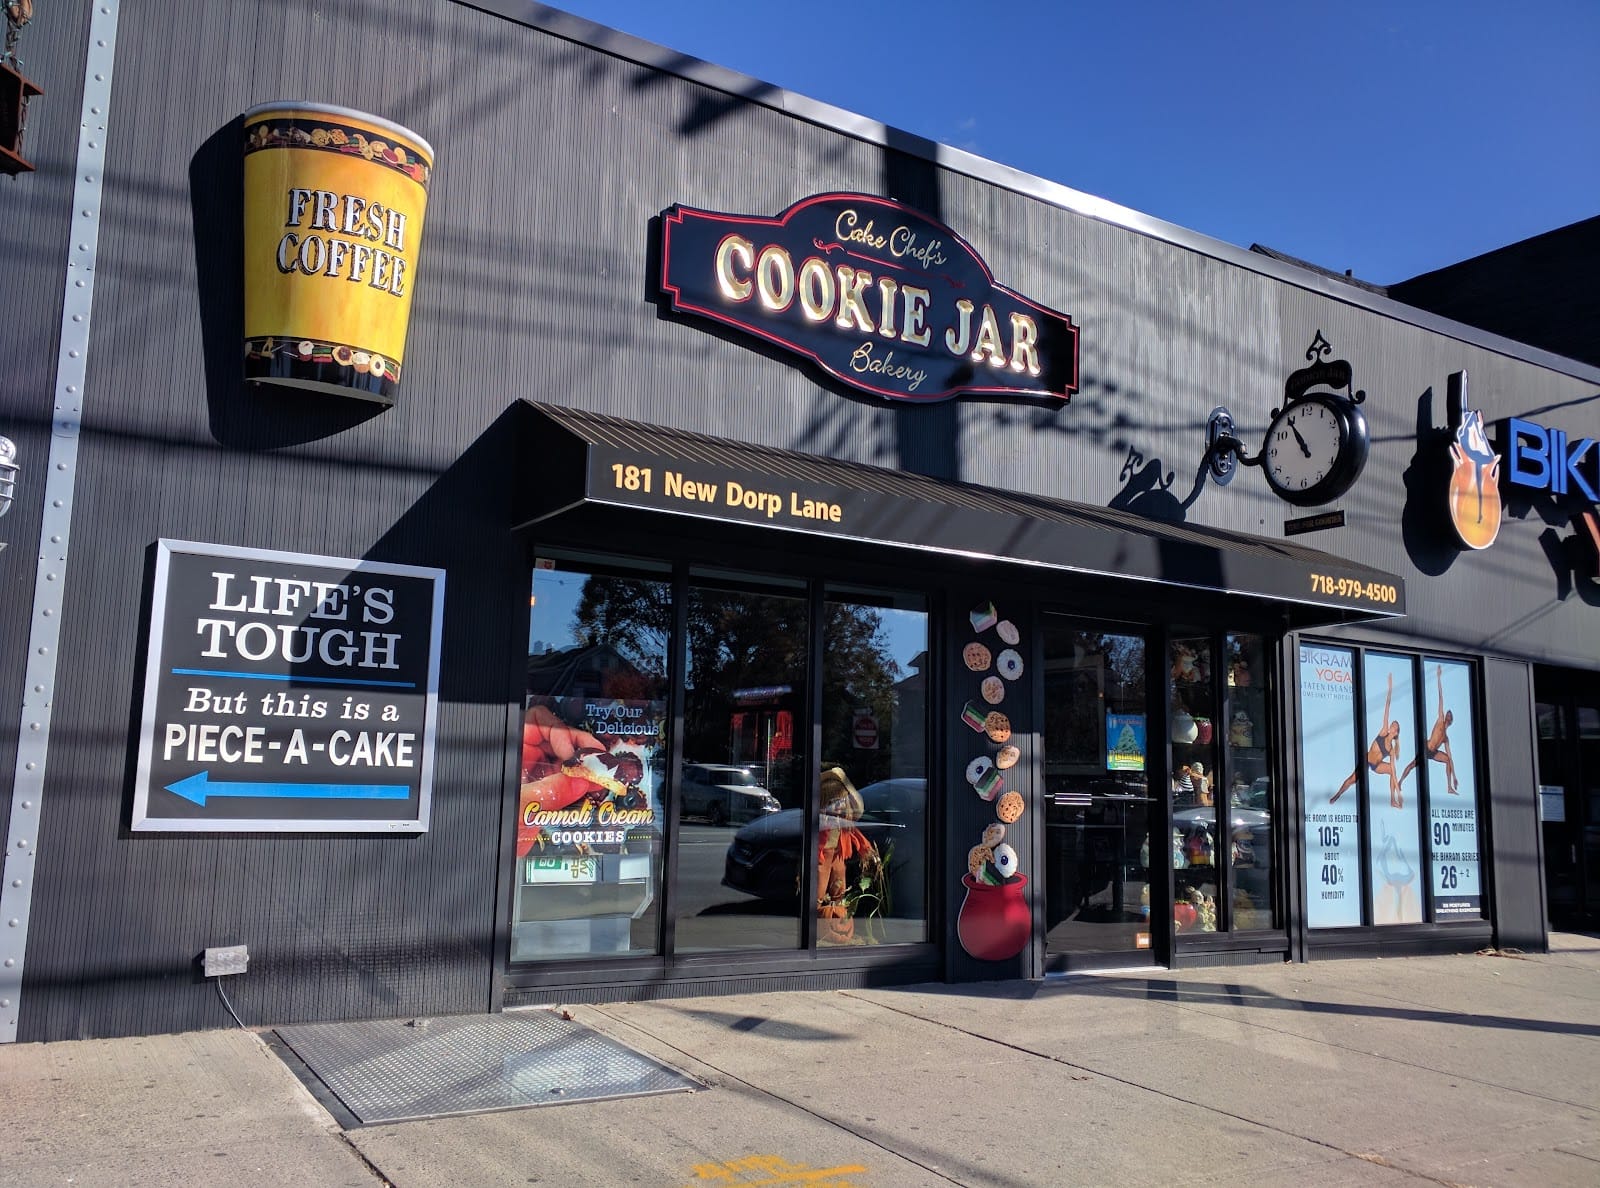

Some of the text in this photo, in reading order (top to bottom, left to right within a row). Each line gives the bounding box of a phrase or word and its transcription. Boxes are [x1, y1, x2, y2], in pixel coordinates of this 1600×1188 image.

[289, 188, 407, 252] FRESH
[835, 209, 947, 270] Cake Chef's
[276, 232, 407, 298] COFFEE
[715, 233, 1042, 377] COOKIE JAR
[849, 342, 928, 391] Bakery
[1510, 417, 1600, 504] BIK
[611, 463, 842, 523] 181 New Dorp Lane
[209, 571, 394, 625] LIFE'S
[1311, 574, 1397, 604] 718-979-4500
[196, 618, 402, 670] TOUGH
[1302, 682, 1326, 692] TATEN
[1316, 668, 1353, 683] YOGA
[183, 687, 400, 722] But this is a
[585, 704, 643, 720] Try Our
[596, 721, 659, 736] Delicious
[163, 723, 416, 768] PIECE-A-CAKE
[523, 799, 655, 828] Cannoli Cream
[1312, 813, 1327, 823] ROOM
[1328, 814, 1333, 823] IS
[1334, 814, 1351, 823] HEATED
[1431, 809, 1475, 819] ALL CLASSES ARE
[552, 831, 625, 844] COOKIES
[1434, 822, 1451, 846] 90
[1452, 823, 1475, 832] MINUTES
[1324, 852, 1340, 861] ABOUT
[1431, 852, 1479, 861] HE BIKRAM SERIES
[1321, 864, 1343, 885] 40%
[1441, 865, 1457, 889] 26
[1321, 890, 1345, 900] HUMIDITY
